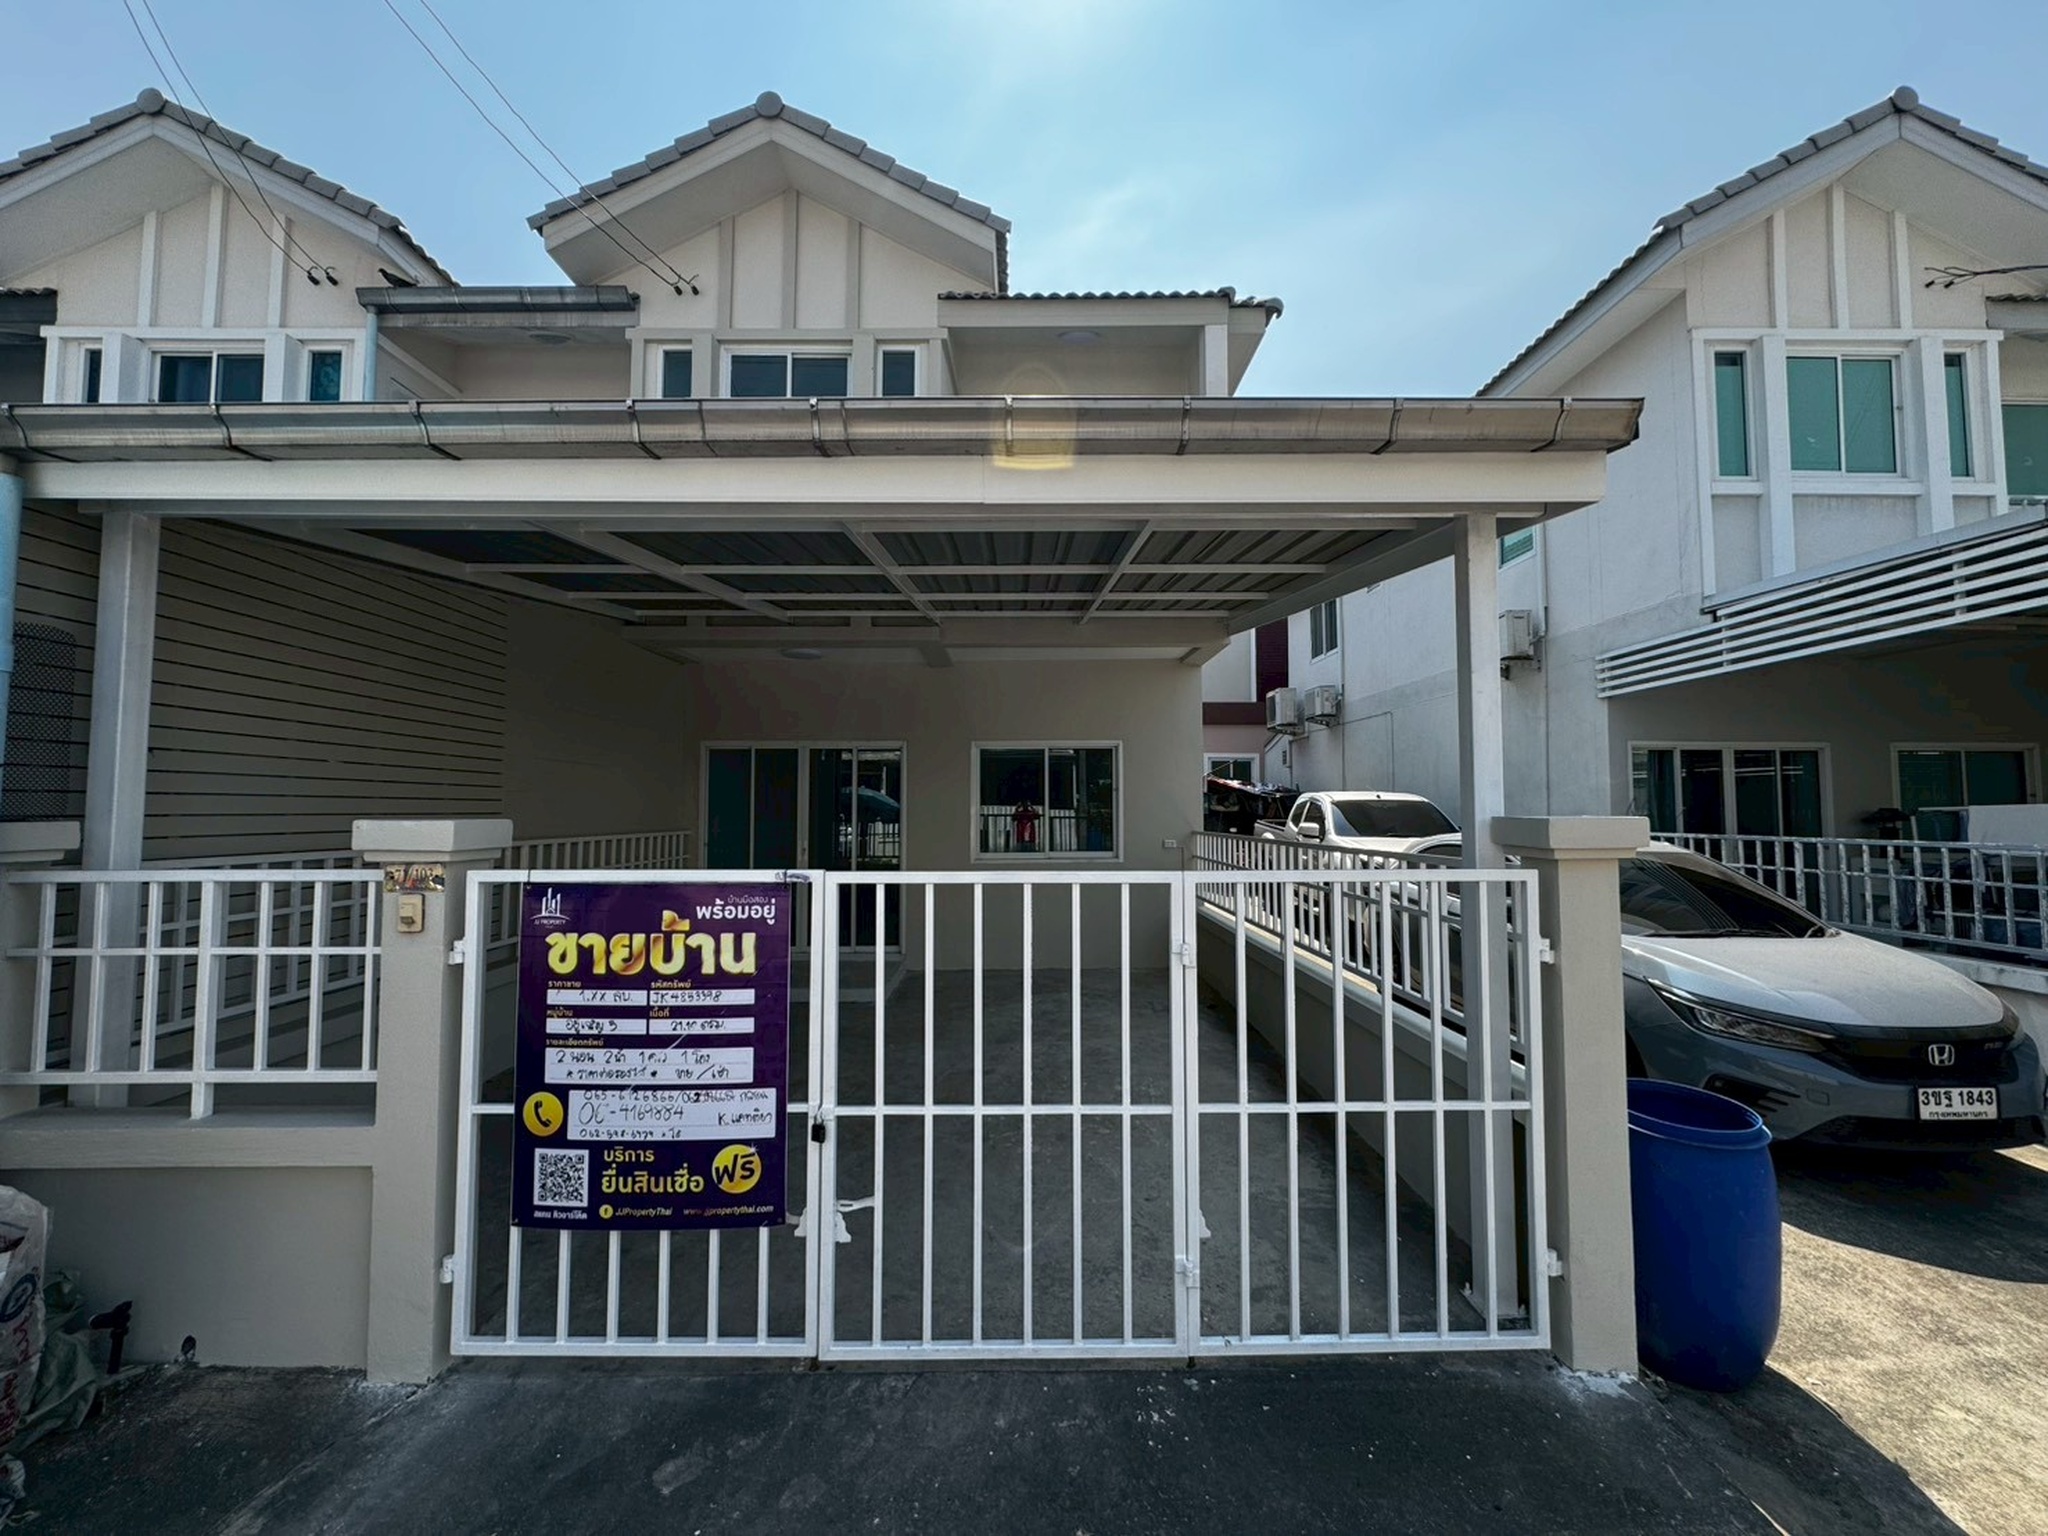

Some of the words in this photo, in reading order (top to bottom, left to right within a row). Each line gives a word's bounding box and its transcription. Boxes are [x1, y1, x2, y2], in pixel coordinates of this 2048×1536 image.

[696, 898, 776, 925] พร้อมอยู่
[545, 909, 757, 975] ขายบ้าน
[548, 980, 582, 988] ราคาขาย
[650, 979, 692, 989] รหัสทรัพย์
[1958, 1090, 1994, 1106] 1843
[603, 1146, 655, 1162] บริการ
[714, 1152, 757, 1185] ฟรี
[601, 1163, 705, 1194] ยื่นสินเชื่อ
[615, 1206, 673, 1217] JJPropertyThai
